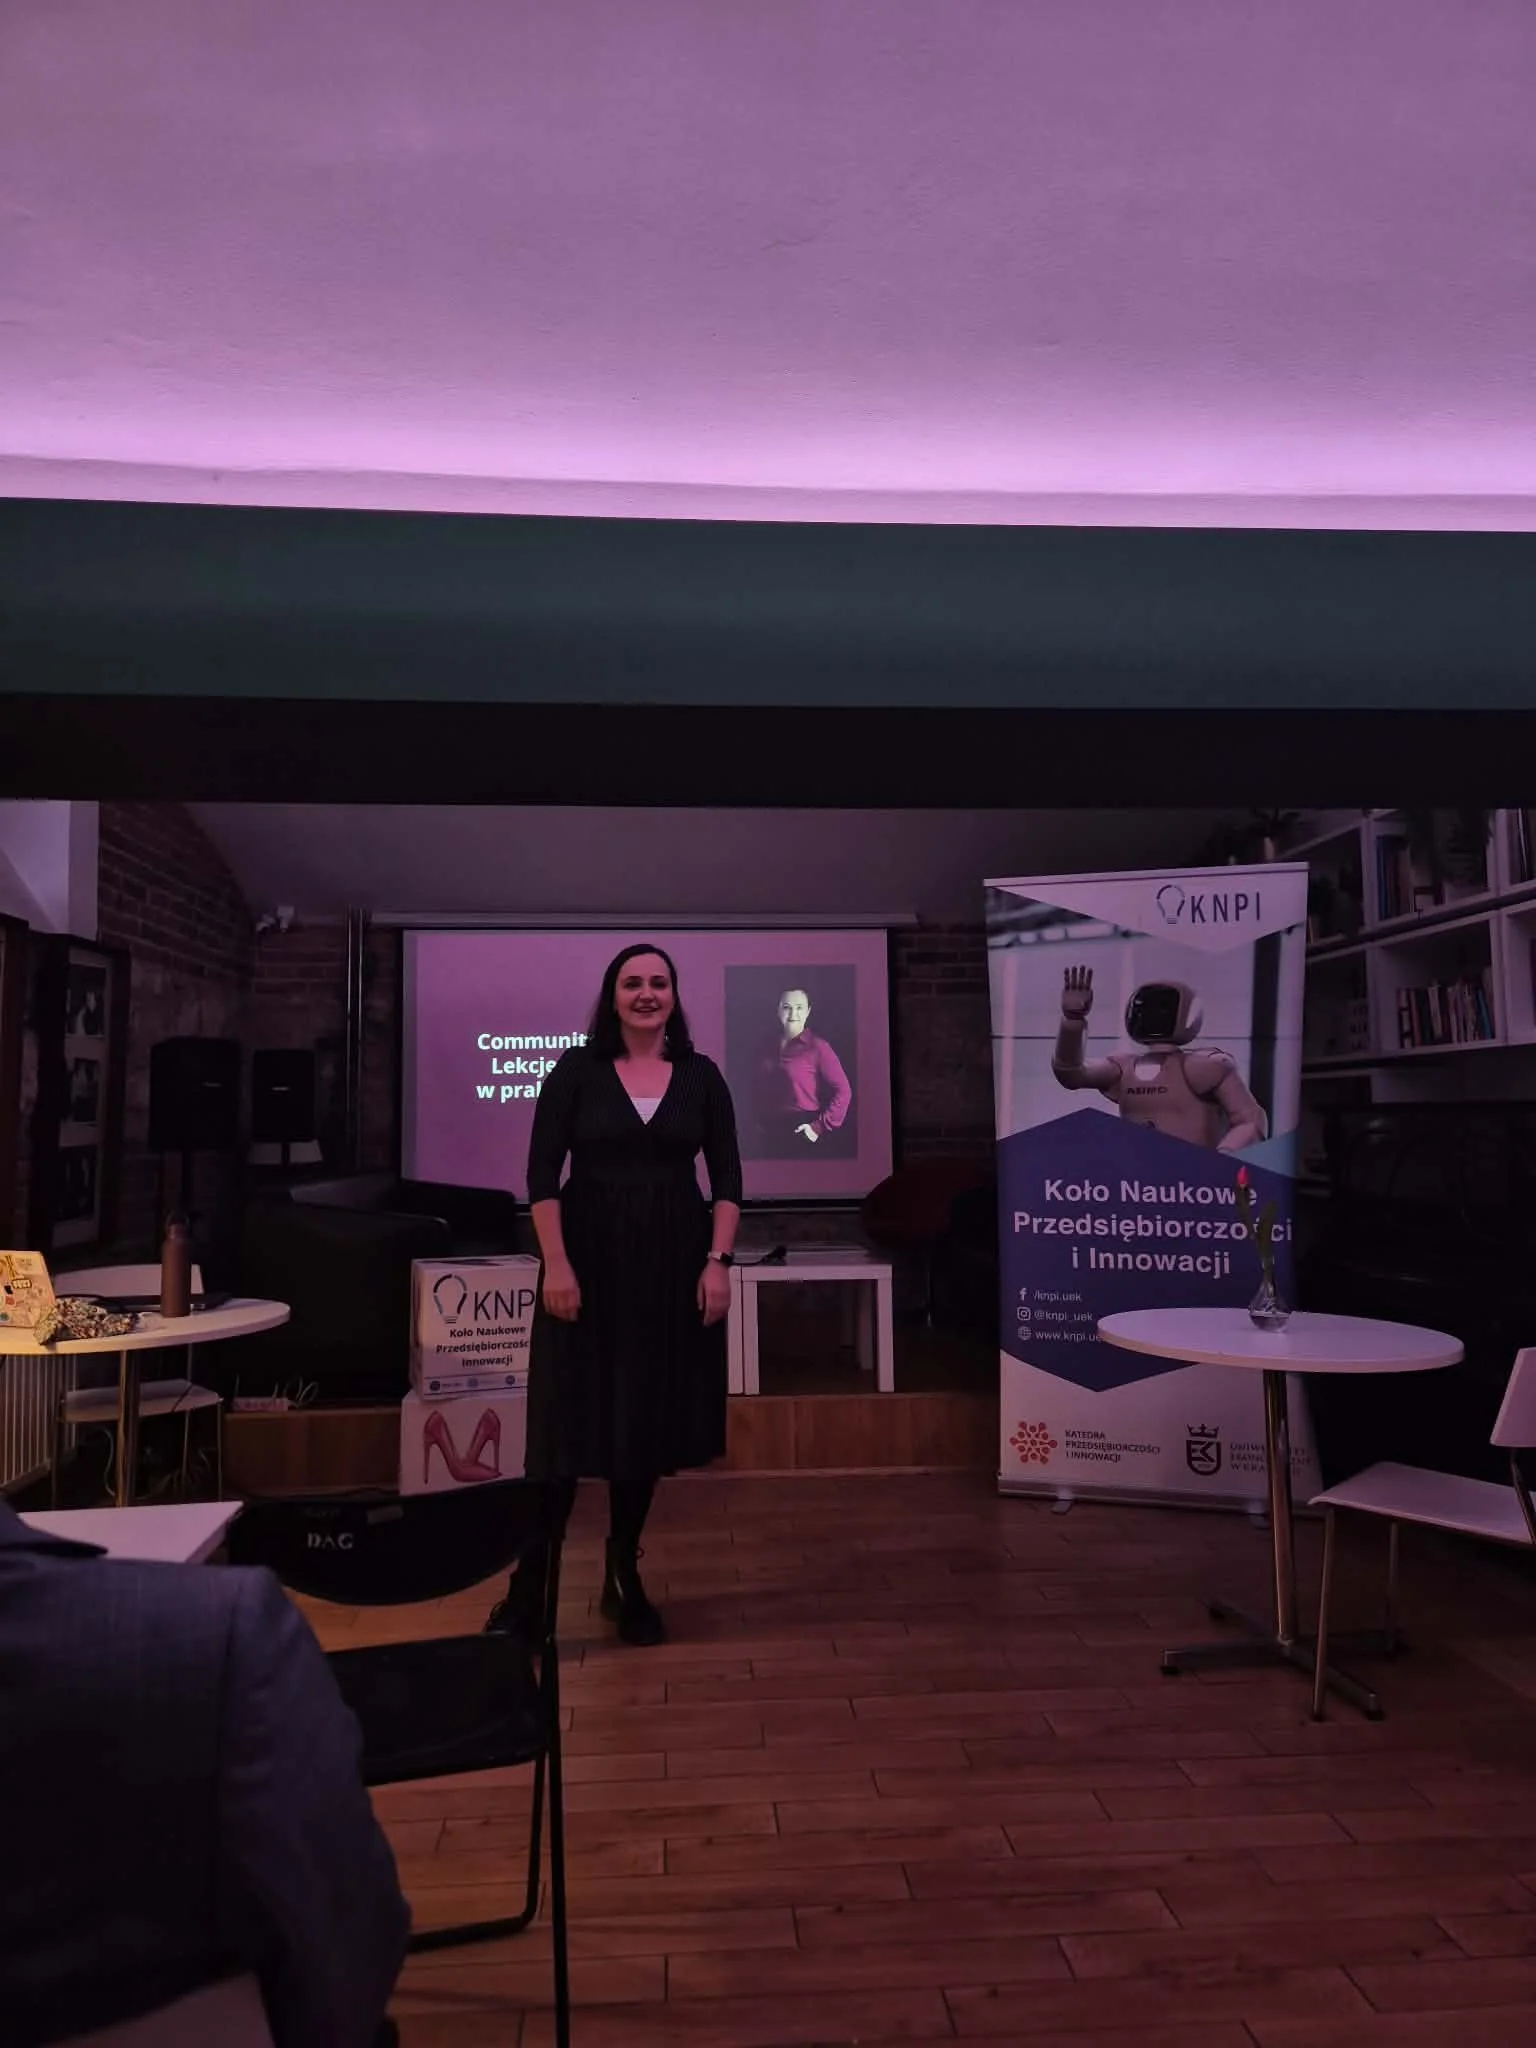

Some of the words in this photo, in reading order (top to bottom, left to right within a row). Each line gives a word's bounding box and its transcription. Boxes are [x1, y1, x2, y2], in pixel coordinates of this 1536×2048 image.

[1190, 891, 1261, 924] KNPI
[477, 1032, 592, 1051] Communit
[491, 1057, 556, 1078] Lekcje
[476, 1085, 496, 1099] w
[1045, 1179, 1110, 1203] Koło
[1072, 1246, 1079, 1269] i
[1089, 1247, 1231, 1280] Innowacji
[474, 1288, 536, 1321] KNP
[476, 1325, 526, 1337] Naukowe
[1035, 1331, 1101, 1344] www.knpi.ue
[435, 1339, 529, 1354] Przedsiębiorczośc
[462, 1354, 513, 1368] Innowacji
[1065, 1429, 1106, 1440] KATEDRA
[1071, 1452, 1121, 1463] INNOWACJI
